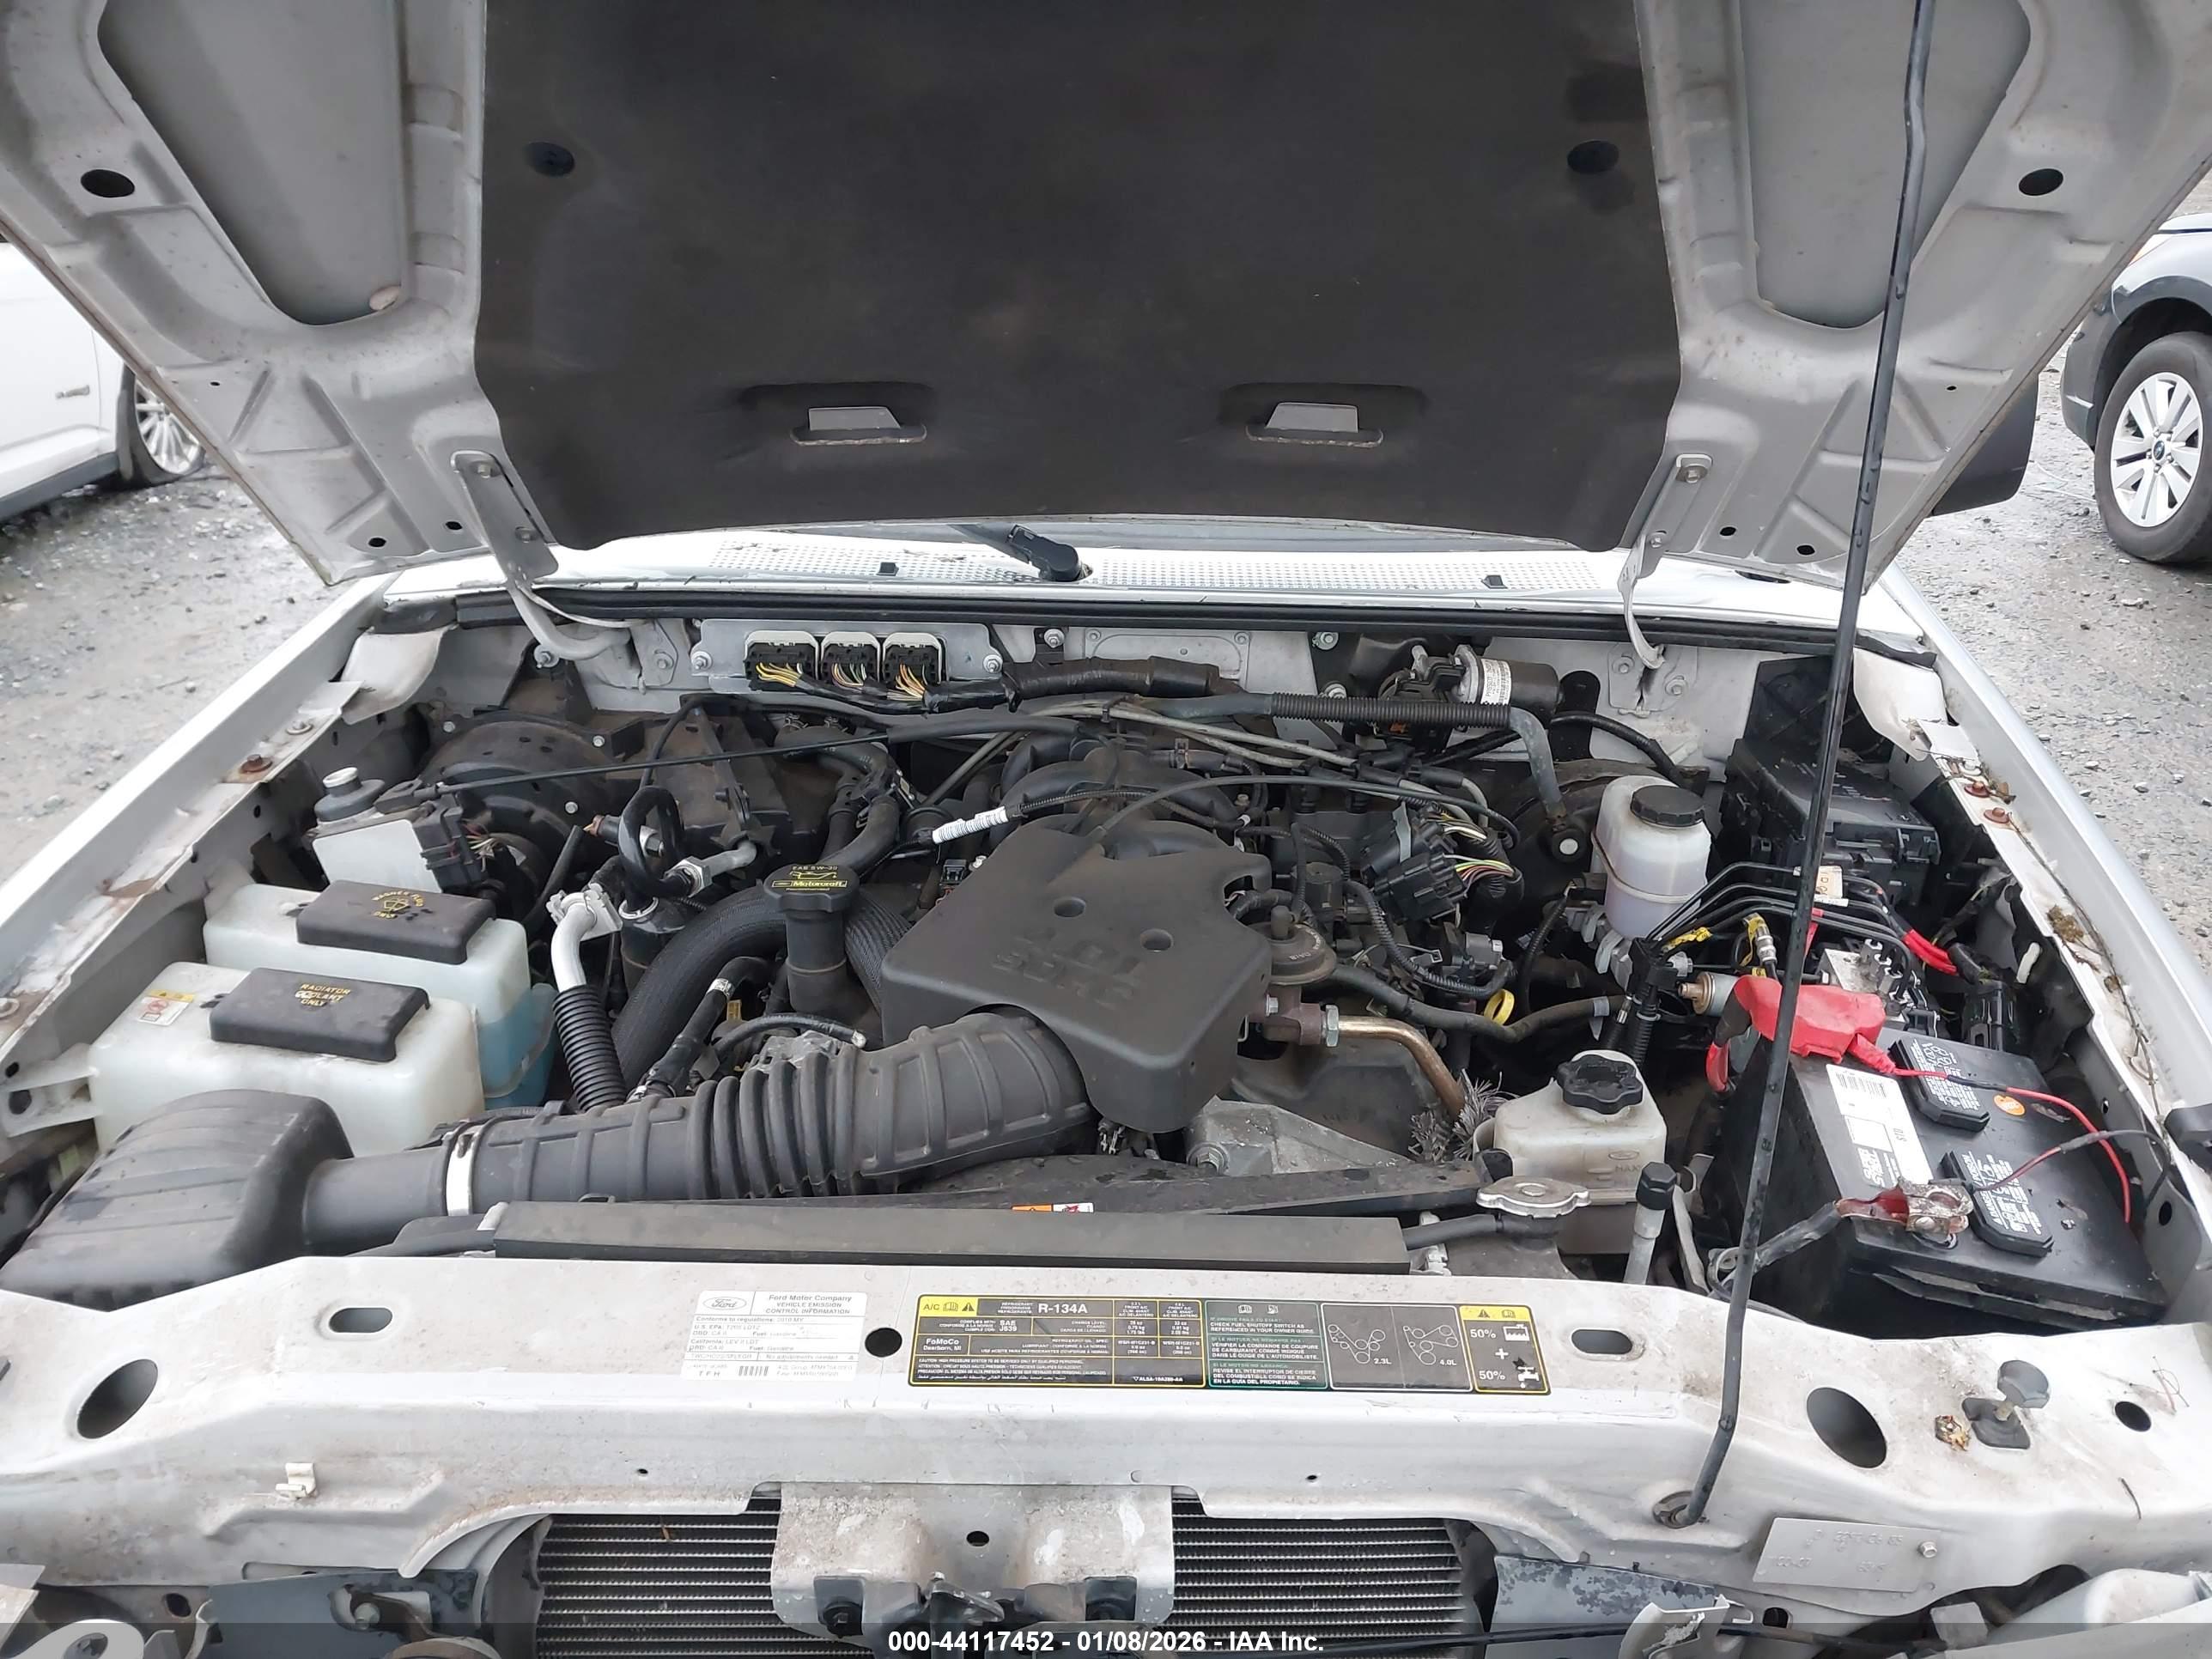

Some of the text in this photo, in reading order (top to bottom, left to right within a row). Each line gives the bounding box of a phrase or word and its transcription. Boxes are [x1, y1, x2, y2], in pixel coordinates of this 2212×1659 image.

[301, 984, 351, 995] RADIATOR
[301, 999, 328, 1007] ONLY
[711, 1298, 738, 1308] Ford
[1037, 1303, 1088, 1314] R-134A
[1470, 1328, 1497, 1339] 50%
[1479, 1370, 1506, 1381] 50%
